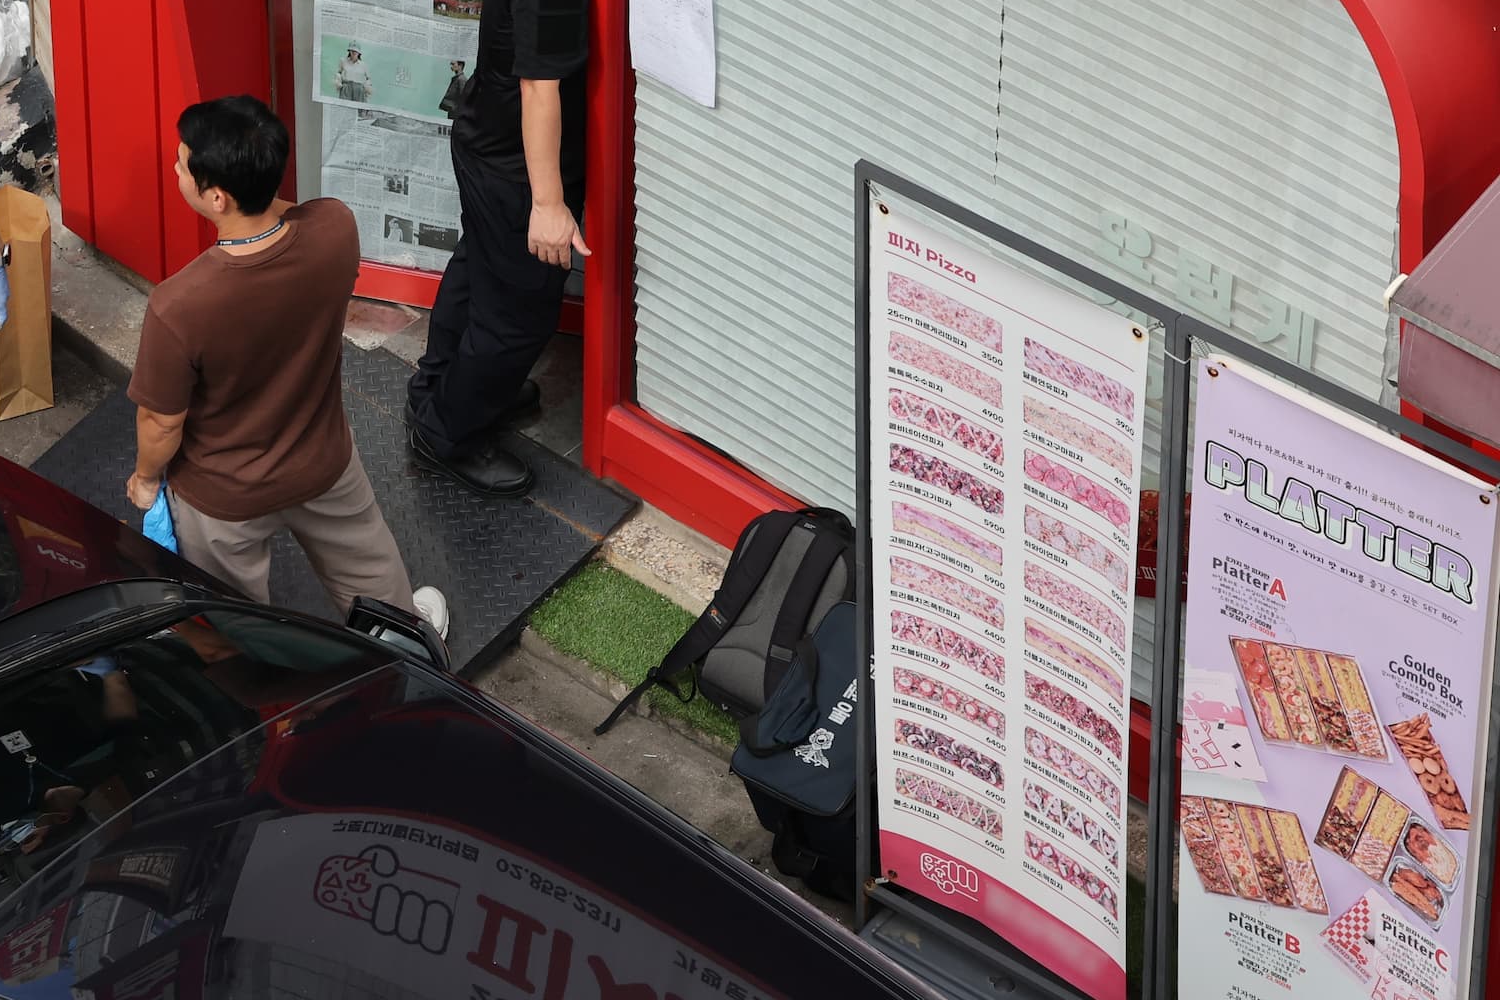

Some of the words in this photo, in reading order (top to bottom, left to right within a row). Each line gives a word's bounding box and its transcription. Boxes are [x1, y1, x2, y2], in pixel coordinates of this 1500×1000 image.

[888, 232, 921, 257] 피자
[927, 247, 977, 284] Pizza
[887, 308, 913, 324] 25cm
[981, 351, 1003, 367] 3500
[982, 408, 1004, 424] 4900
[1115, 418, 1135, 437] 3900
[1022, 429, 1084, 463] 스위트고구마피자
[983, 462, 1005, 479] 5900
[1113, 476, 1132, 495] 4900
[1307, 464, 1324, 477] 피자
[1326, 472, 1342, 484] SET
[1437, 524, 1462, 540] 시리즈
[983, 518, 1005, 534] 5900
[1206, 440, 1473, 604] PLATTER
[1112, 532, 1130, 551] 5900
[1024, 539, 1068, 567] 하와이안피자
[1235, 518, 1260, 534] 박스에
[1302, 549, 1324, 564] 4가지
[1328, 560, 1336, 570] 맛
[1340, 567, 1364, 583] 피자를
[1369, 578, 1386, 592] 즐길
[1390, 588, 1398, 597] 수
[1402, 594, 1418, 607] 있는
[1423, 603, 1437, 615] SET
[1441, 612, 1459, 625] BOX
[984, 573, 1005, 590] 5900
[1111, 590, 1127, 609] 5900
[984, 628, 1006, 644] 6400
[1109, 646, 1126, 666] 5900
[1404, 654, 1451, 688] Golden
[985, 682, 1006, 698] 6400
[1389, 661, 1435, 692] Combo
[1440, 686, 1463, 710] Box
[1108, 702, 1124, 721] 6400
[986, 736, 1006, 752] 6400
[1107, 757, 1123, 776] 6400
[985, 789, 1006, 804] 6900
[1105, 811, 1121, 830] 6900
[985, 839, 1004, 854] 6900
[1104, 865, 1120, 884] 6900
[1102, 915, 1119, 934] 6900
